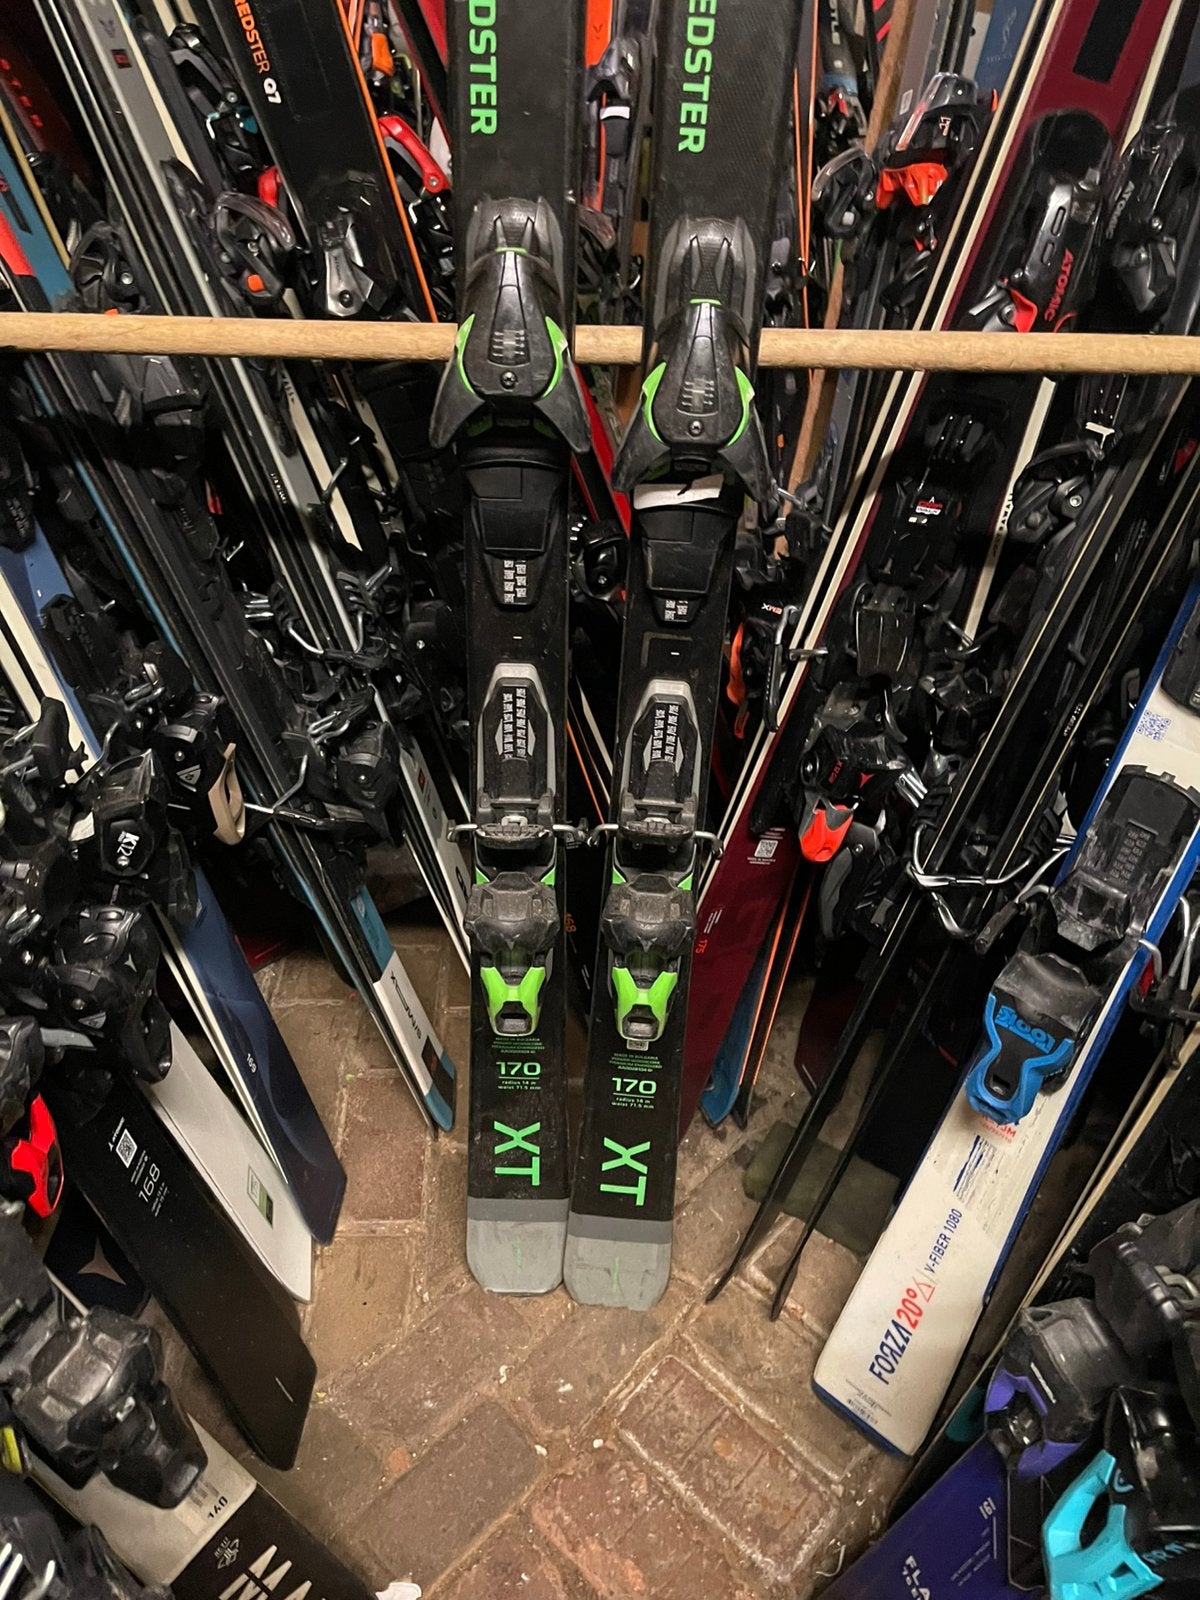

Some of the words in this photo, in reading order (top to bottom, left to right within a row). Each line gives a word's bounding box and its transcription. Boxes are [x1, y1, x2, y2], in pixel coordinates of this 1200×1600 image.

[678, 0, 717, 153] EDSTER
[1044, 247, 1074, 322] ATOMIC
[994, 1005, 1056, 1054] LOOK
[495, 1061, 541, 1076] 170
[611, 1077, 657, 1095] 170
[138, 1163, 160, 1202] 168
[494, 1120, 541, 1187] XT
[600, 1137, 651, 1206] XT
[869, 1319, 912, 1385] FORZA
[924, 1232, 951, 1275] V-FIBER
[943, 1208, 963, 1234] 1080
